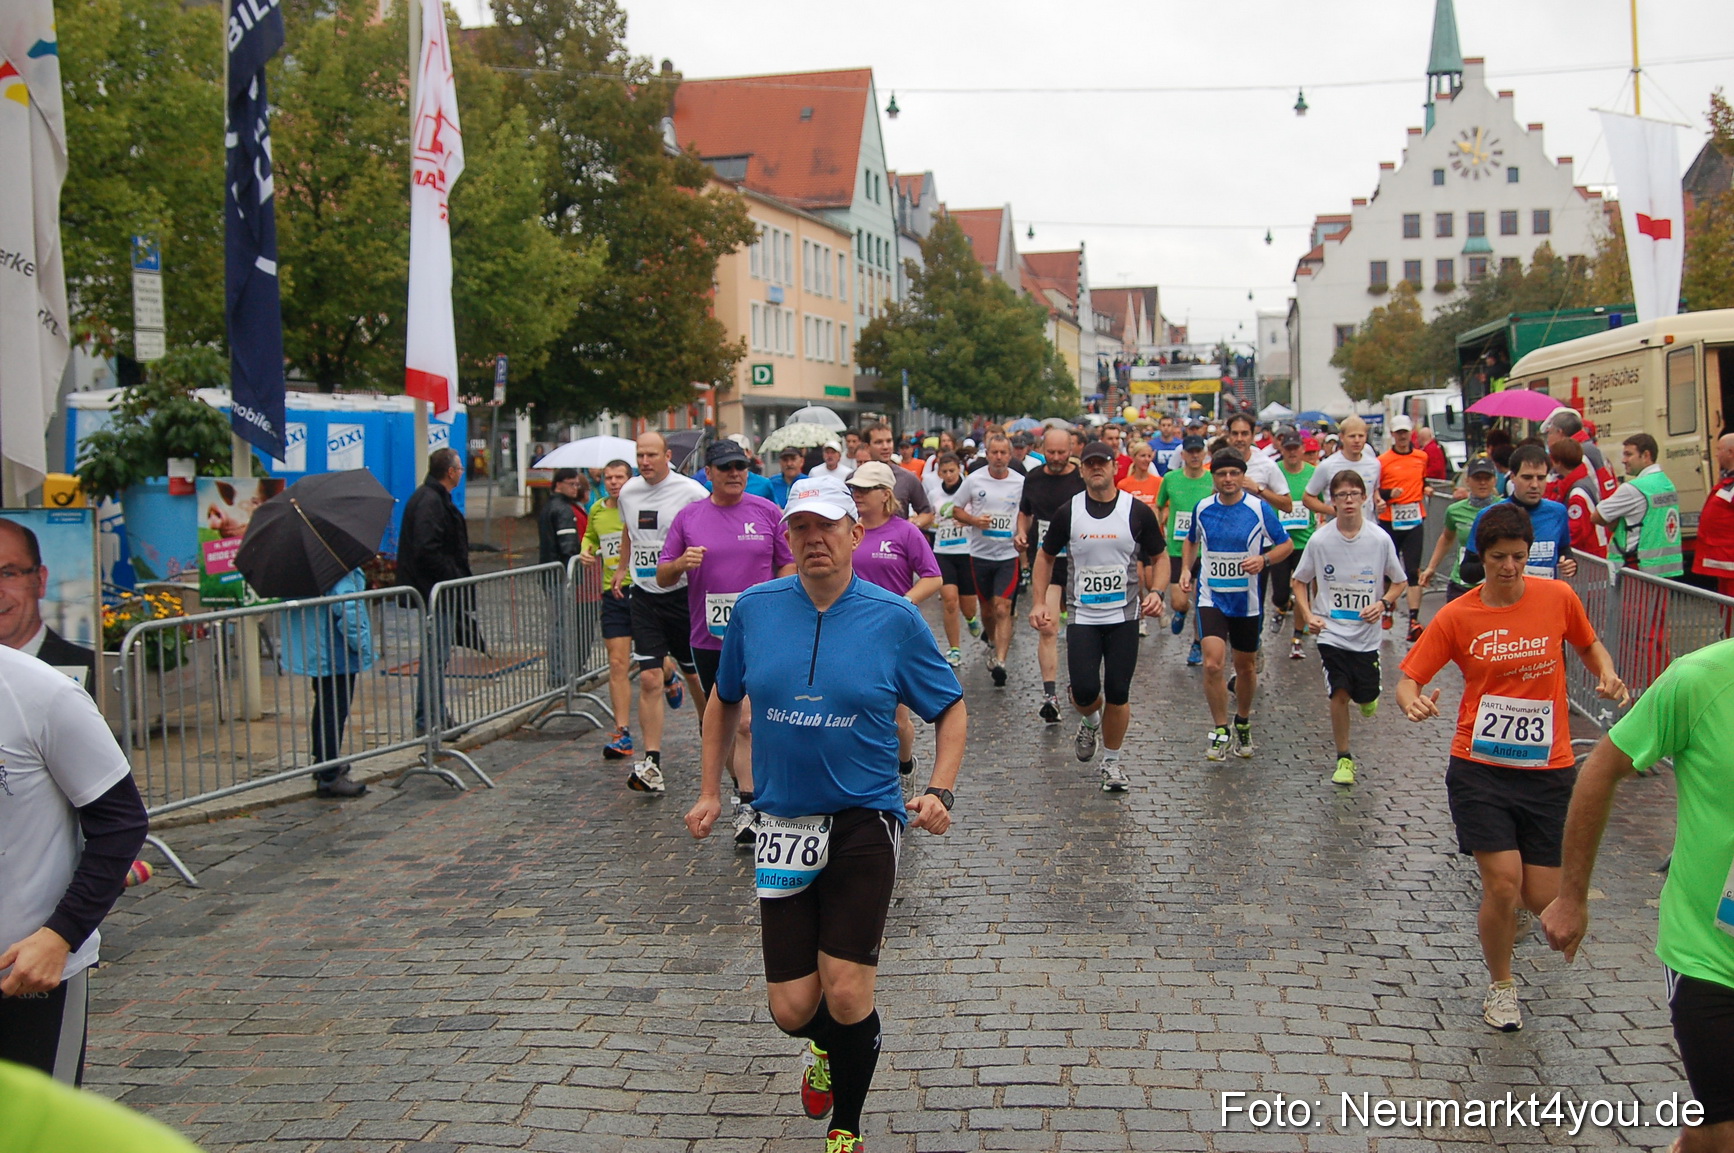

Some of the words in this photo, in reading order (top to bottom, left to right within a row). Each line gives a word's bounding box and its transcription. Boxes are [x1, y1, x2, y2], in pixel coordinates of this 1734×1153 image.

[228, 0, 280, 52] BIL
[754, 366, 771, 384] D
[1589, 367, 1640, 394] Bayerisches
[1589, 396, 1612, 415] Rotes
[744, 522, 757, 534] K
[880, 540, 892, 553] K
[634, 550, 662, 567] 254
[1211, 561, 1246, 577] 3080
[1084, 575, 1122, 592] 2692
[1334, 593, 1371, 609] 3170
[1483, 634, 1549, 656] Fischer
[1490, 648, 1546, 662] AUTOMOBILE
[1481, 701, 1504, 710] PARTL
[1506, 704, 1540, 714] Neumarkt
[824, 713, 858, 728] Lauf
[1481, 712, 1545, 743] 2783
[1492, 745, 1528, 758] Andrea
[774, 820, 816, 832] Neumarkt
[757, 832, 820, 867] 2578
[758, 872, 803, 887] Andreas
